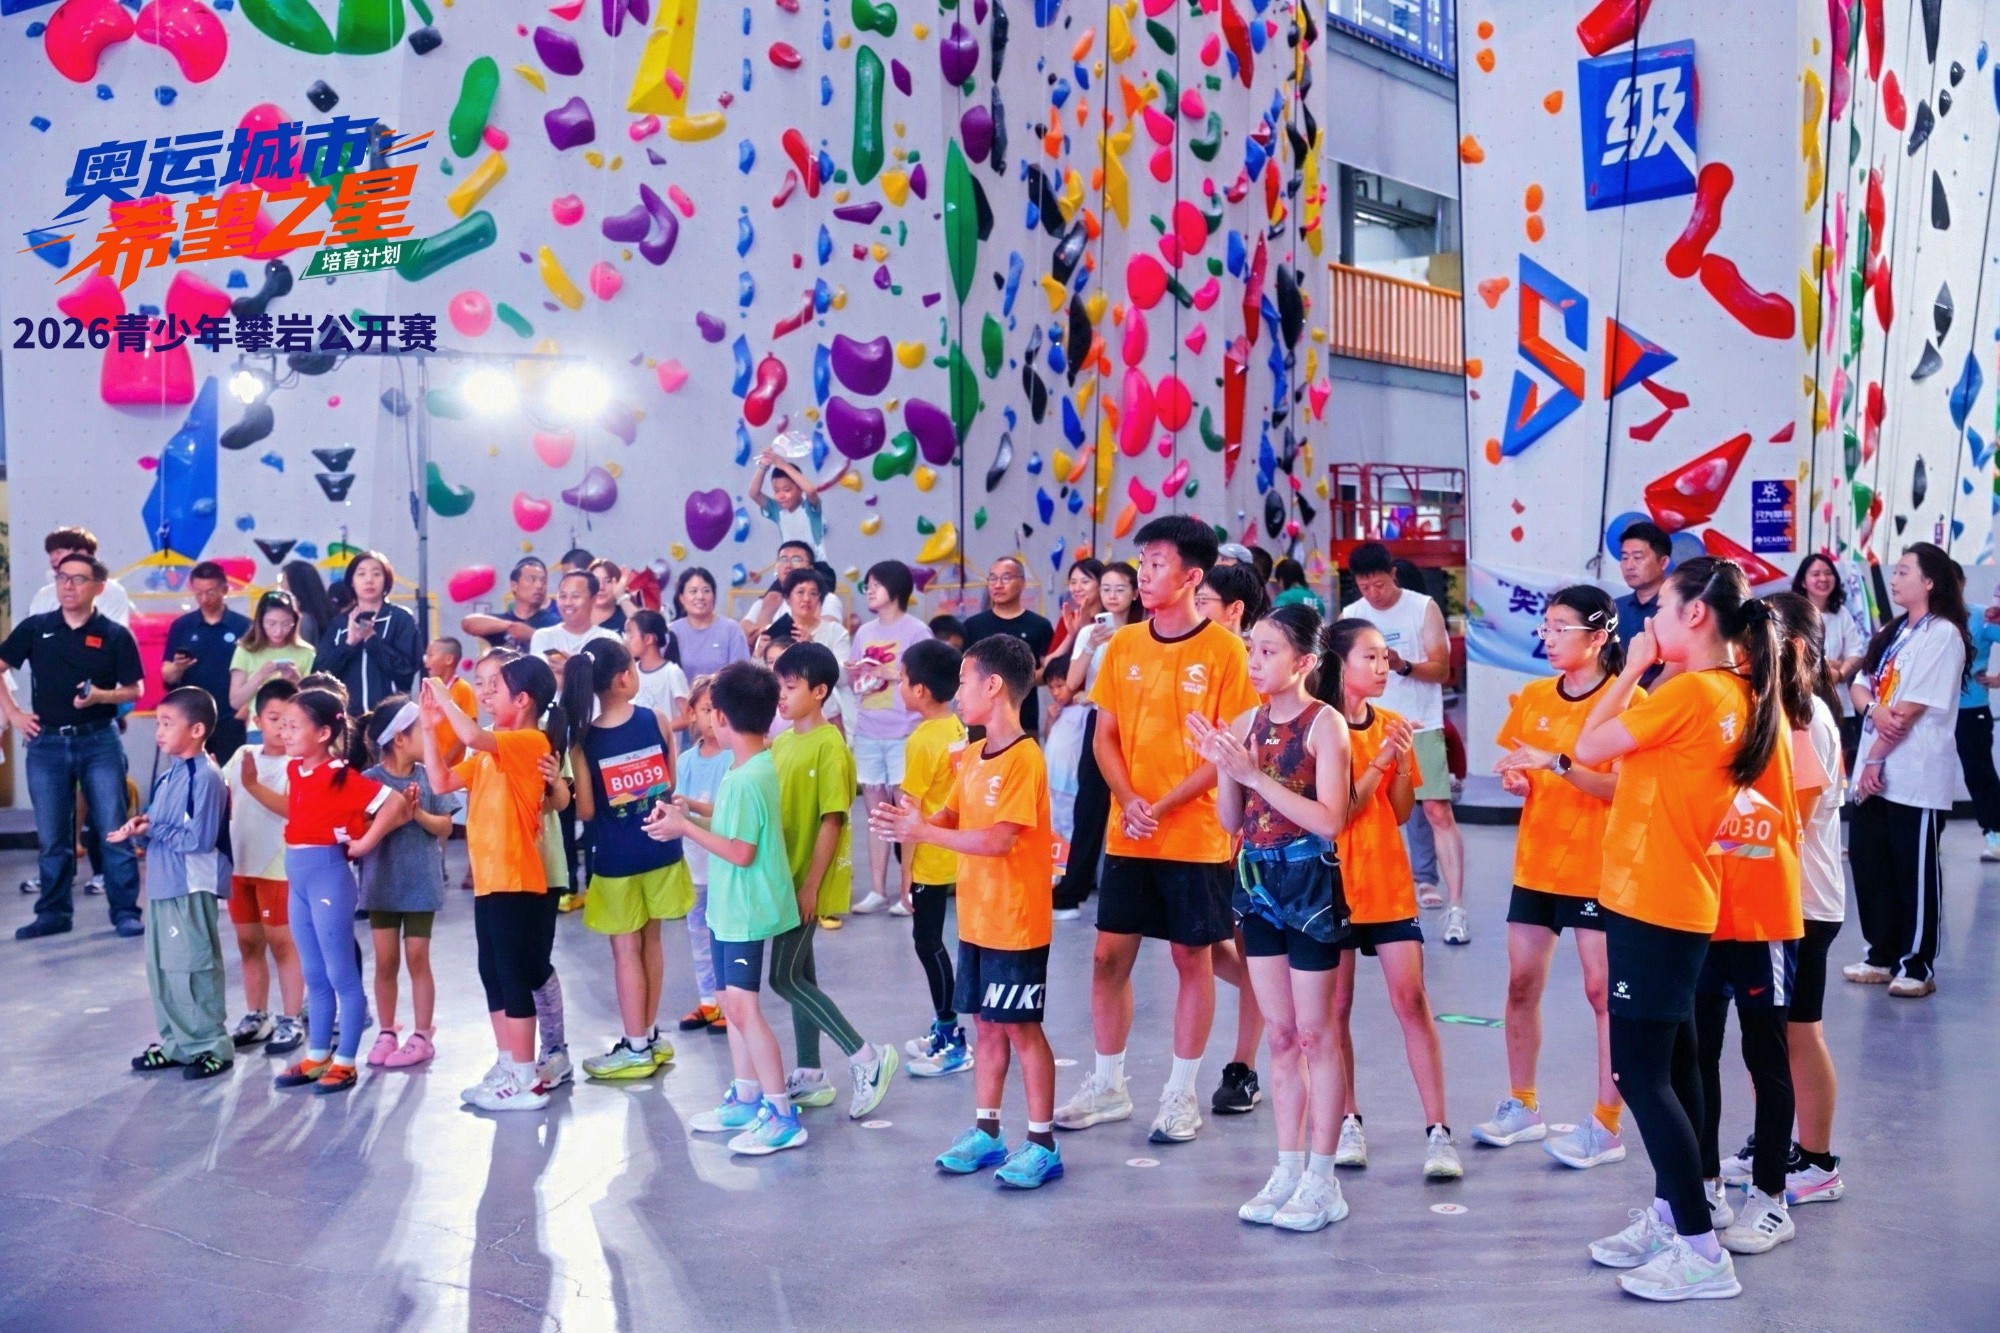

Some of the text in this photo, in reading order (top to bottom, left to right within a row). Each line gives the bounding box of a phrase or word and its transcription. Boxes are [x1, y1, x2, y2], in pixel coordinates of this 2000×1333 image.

[1601, 66, 1697, 177] 级
[610, 765, 664, 792] B0039
[1613, 991, 1631, 1000] KELME
